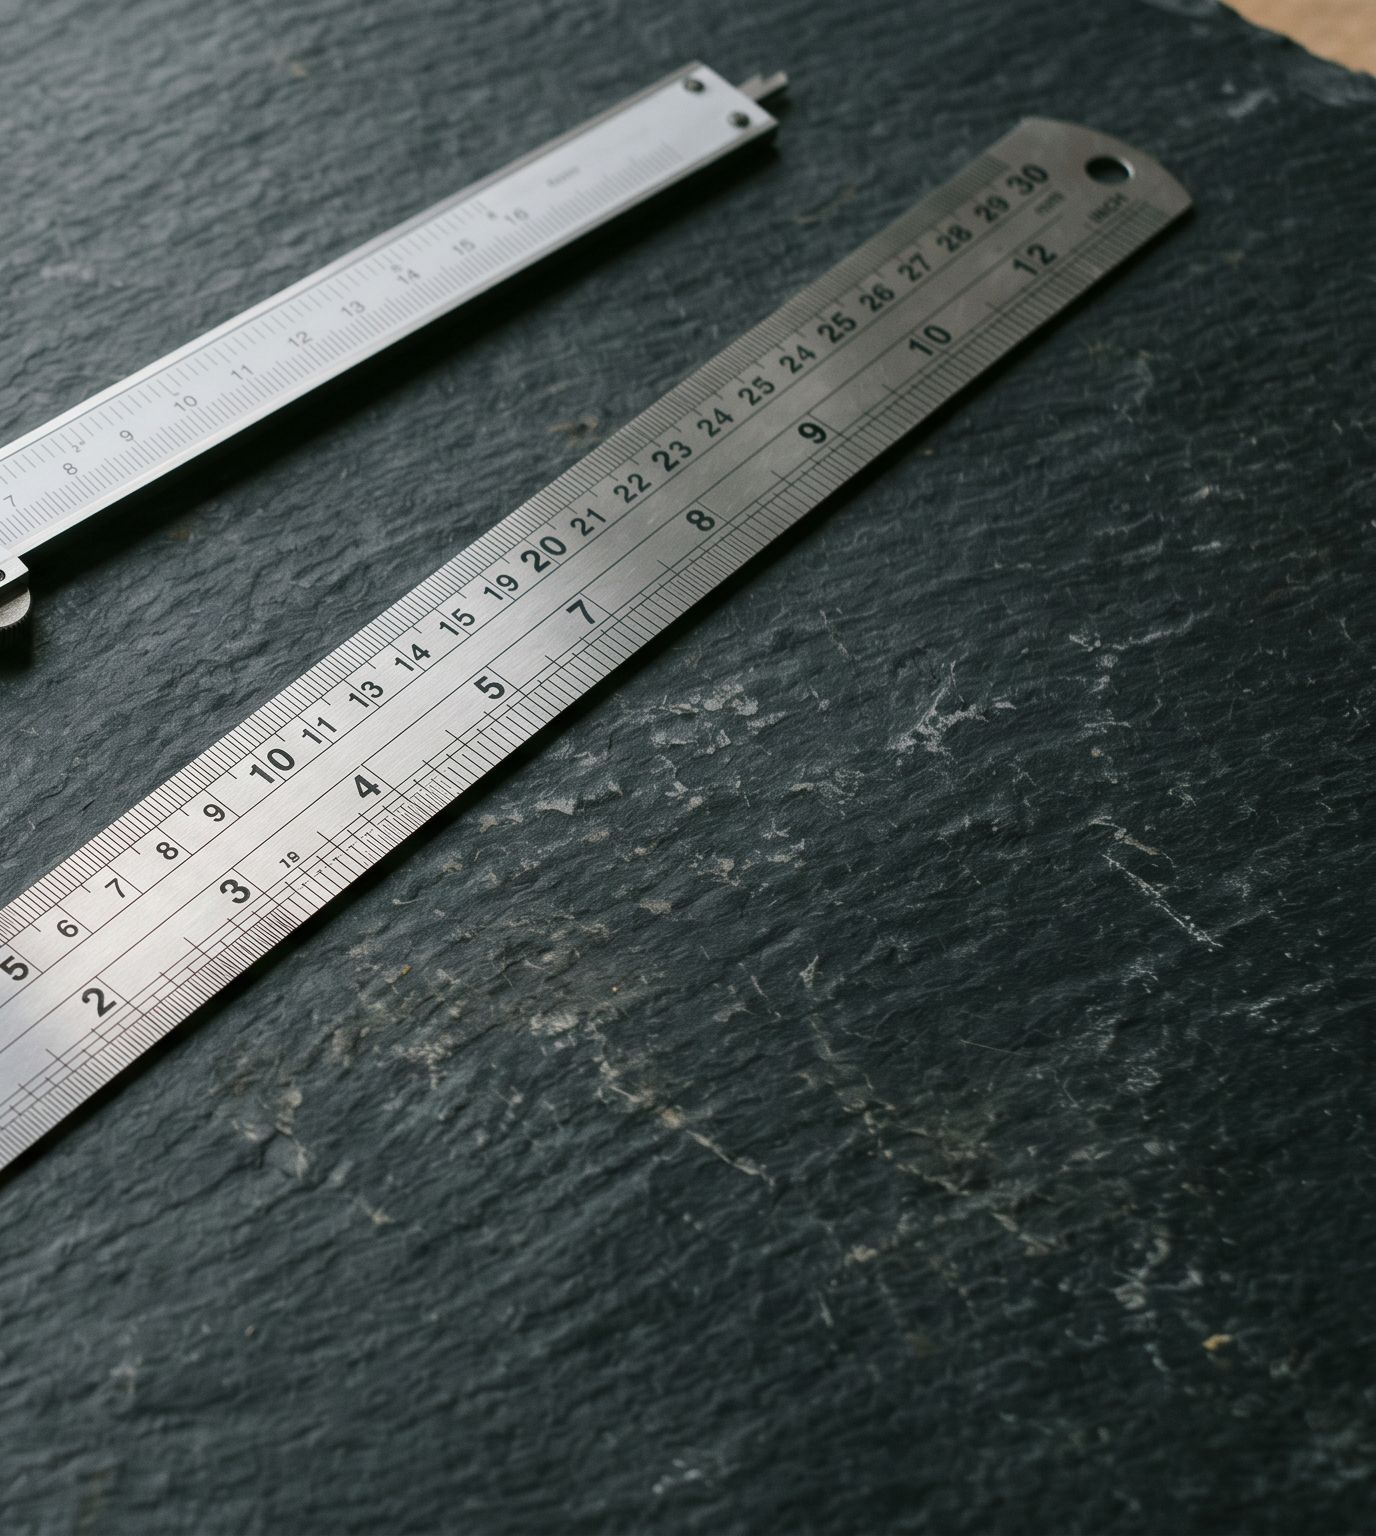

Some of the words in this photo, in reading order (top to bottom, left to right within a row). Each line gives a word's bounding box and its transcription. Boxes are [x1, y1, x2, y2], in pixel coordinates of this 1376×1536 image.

[0, 956, 29, 982] 5
[56, 919, 79, 940] 6
[104, 877, 127, 900] 7
[155, 841, 179, 861] 8
[202, 802, 227, 823] 9
[248, 747, 296, 786] 10
[301, 716, 338, 745] 11
[348, 680, 384, 710] 13
[394, 643, 431, 674] 14
[438, 608, 476, 637] 15
[482, 574, 519, 602] 19
[520, 535, 567, 573] 20
[569, 507, 607, 537] 21
[612, 473, 652, 504] 22
[651, 440, 693, 473] 23
[697, 408, 734, 438] 24
[738, 377, 776, 406] 25
[779, 344, 816, 375] 24
[818, 312, 857, 344] 25
[859, 283, 895, 313] 26
[897, 253, 933, 283] 27
[935, 225, 972, 254] 28
[976, 196, 1010, 223] 29
[1007, 164, 1049, 195] 30
[3, 495, 16, 507] 7
[62, 463, 78, 476] 8
[119, 430, 134, 442] 9
[174, 395, 198, 412] 10
[231, 364, 254, 381] 11
[288, 331, 312, 348] 12
[340, 300, 366, 318] 13
[81, 986, 117, 1017] 2
[219, 877, 251, 904] 3
[353, 774, 380, 801] 4
[473, 676, 505, 701] 5
[566, 601, 597, 628] 7
[686, 508, 715, 533] 8
[798, 421, 827, 446] 9
[908, 324, 953, 359] 10
[1013, 243, 1057, 276] 12
